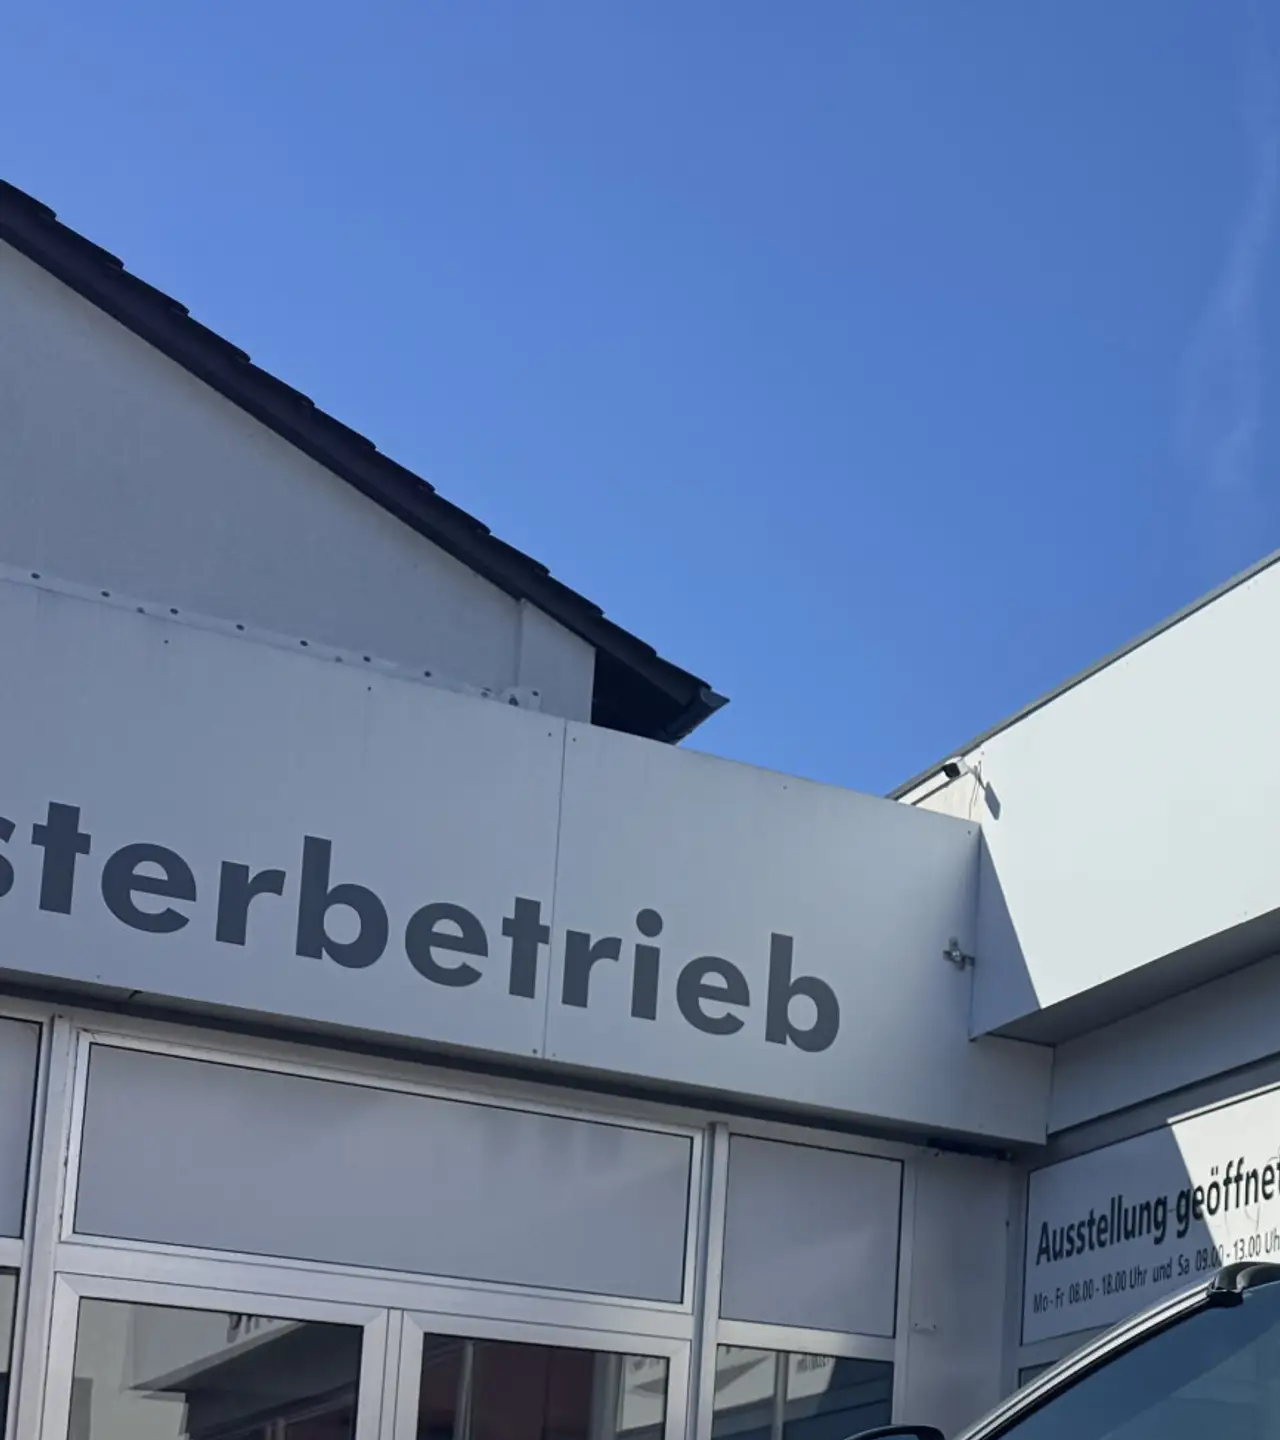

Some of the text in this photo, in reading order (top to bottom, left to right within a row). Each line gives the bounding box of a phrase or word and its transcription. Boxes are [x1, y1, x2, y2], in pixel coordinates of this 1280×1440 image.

[0, 801, 841, 1053] terbetrieb
[1035, 1194, 1168, 1266] Ausstellung
[1129, 1264, 1148, 1290] Uhr
[1152, 1257, 1173, 1283] und
[1177, 1254, 1190, 1277] Sa
